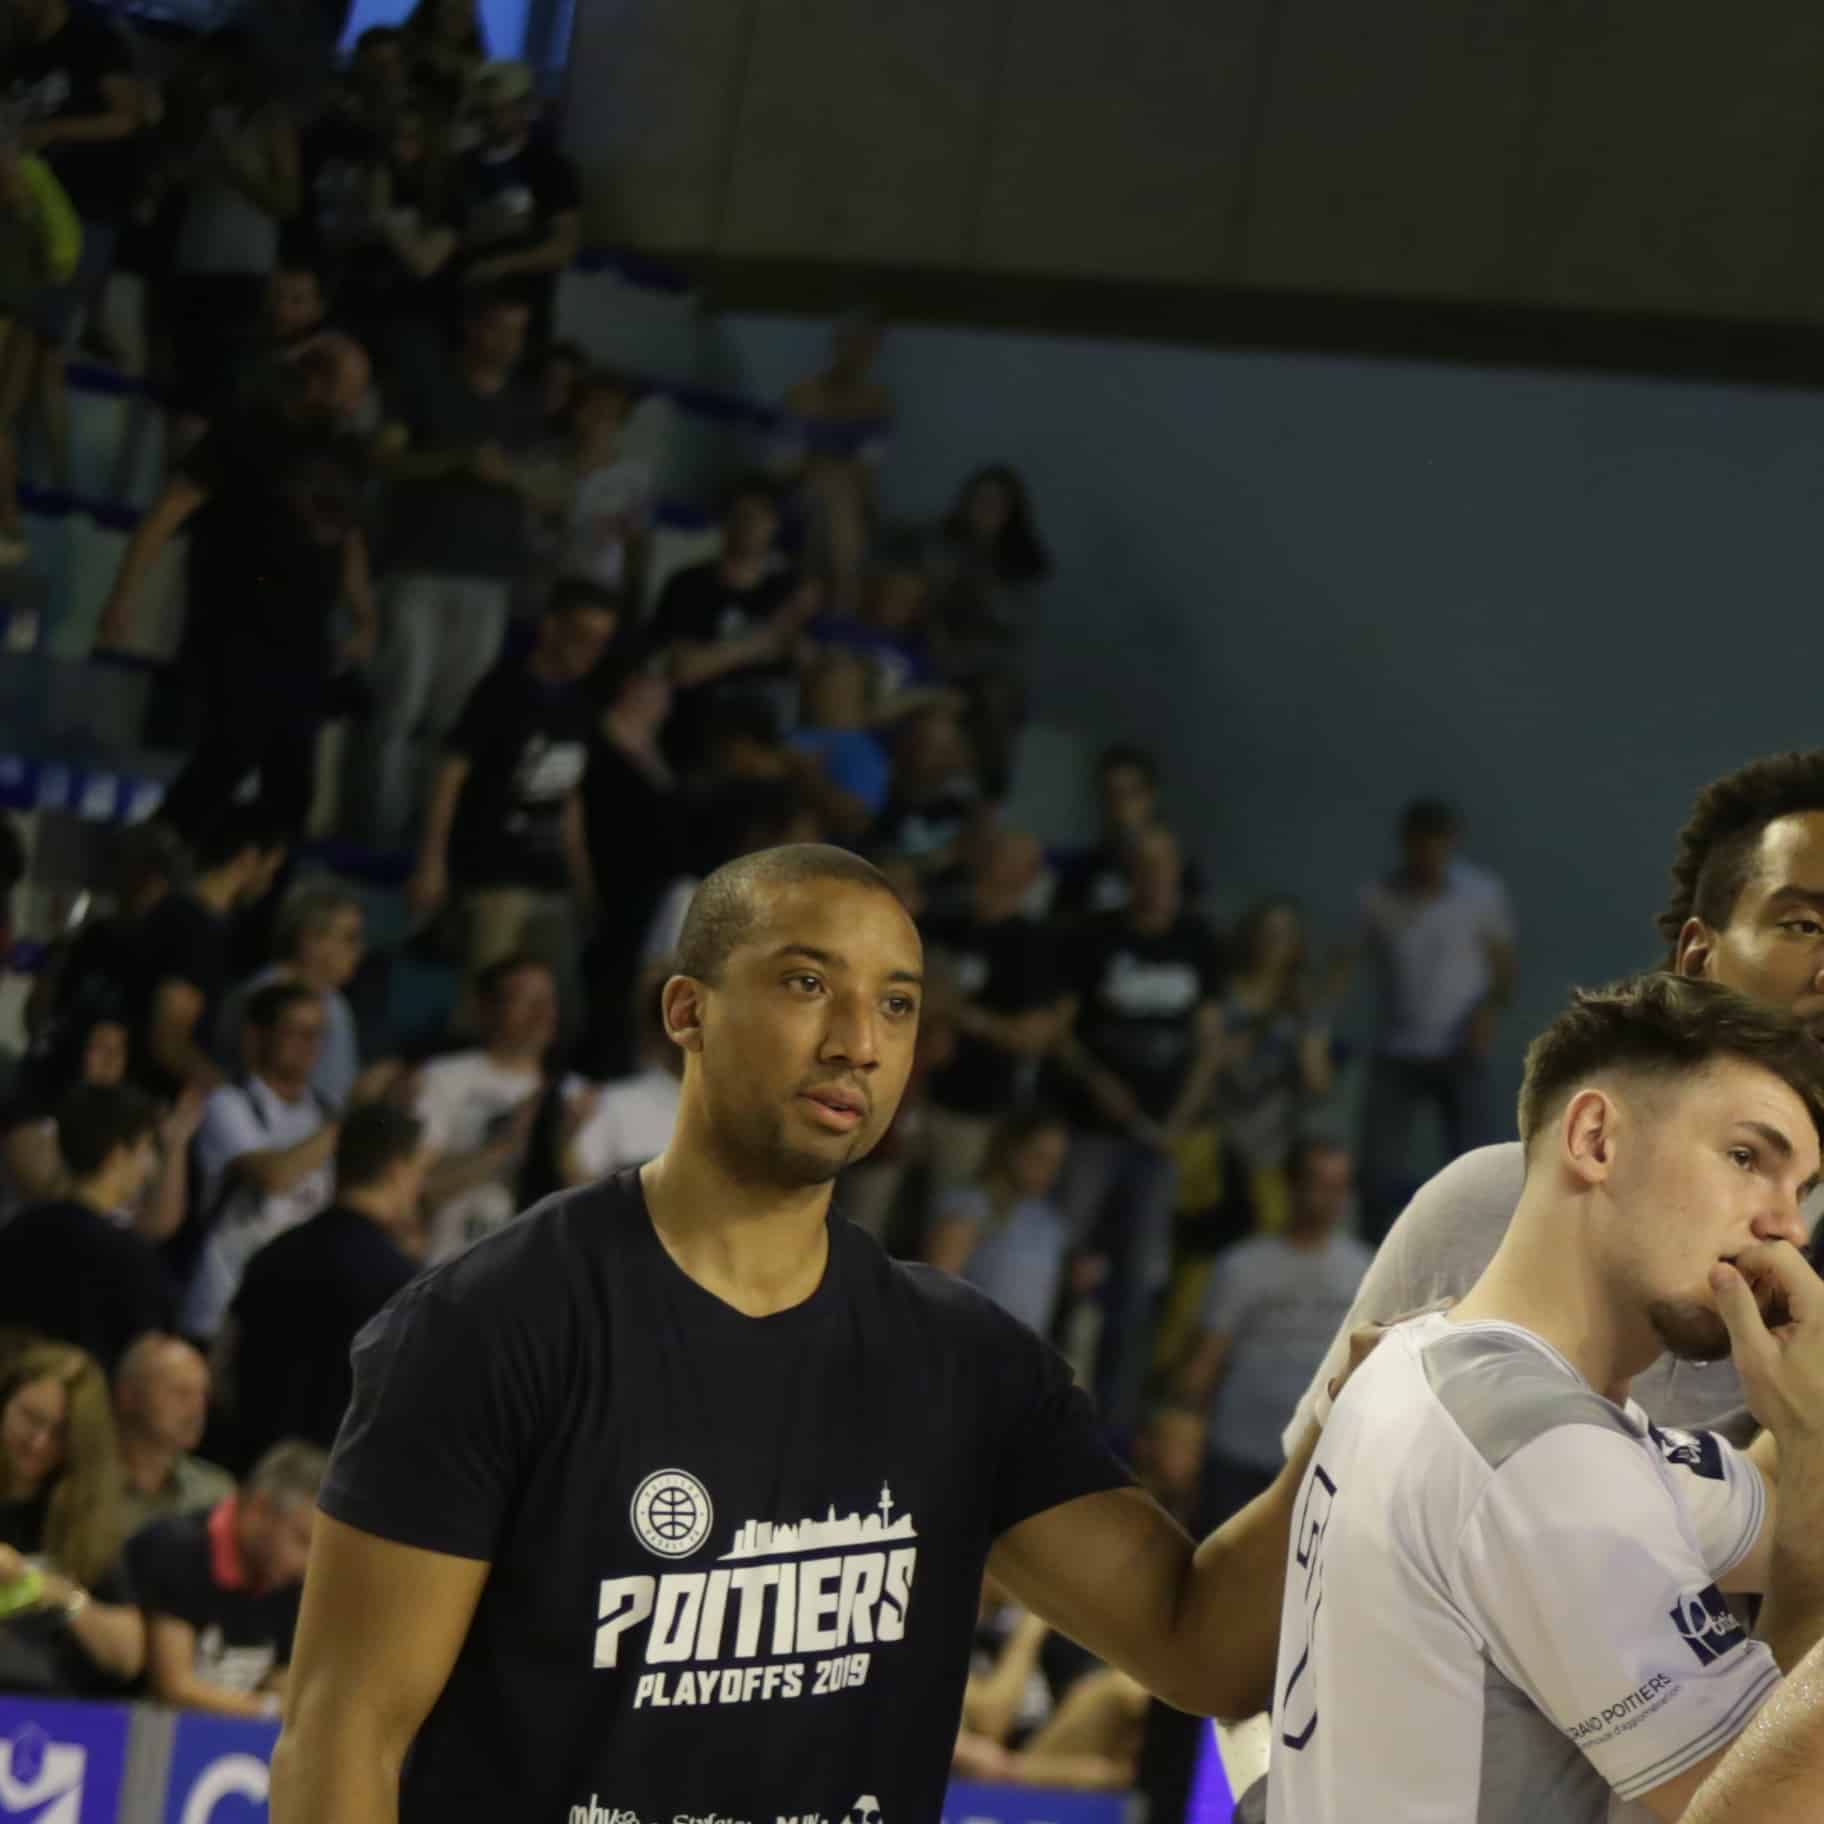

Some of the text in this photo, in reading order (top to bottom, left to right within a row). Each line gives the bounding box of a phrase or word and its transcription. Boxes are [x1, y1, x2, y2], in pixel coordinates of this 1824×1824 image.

[593, 1547, 917, 1669] POITIERS
[633, 1652, 871, 1709] PLAYOFFS 2019
[1601, 1672, 1672, 1725] POITIERS
